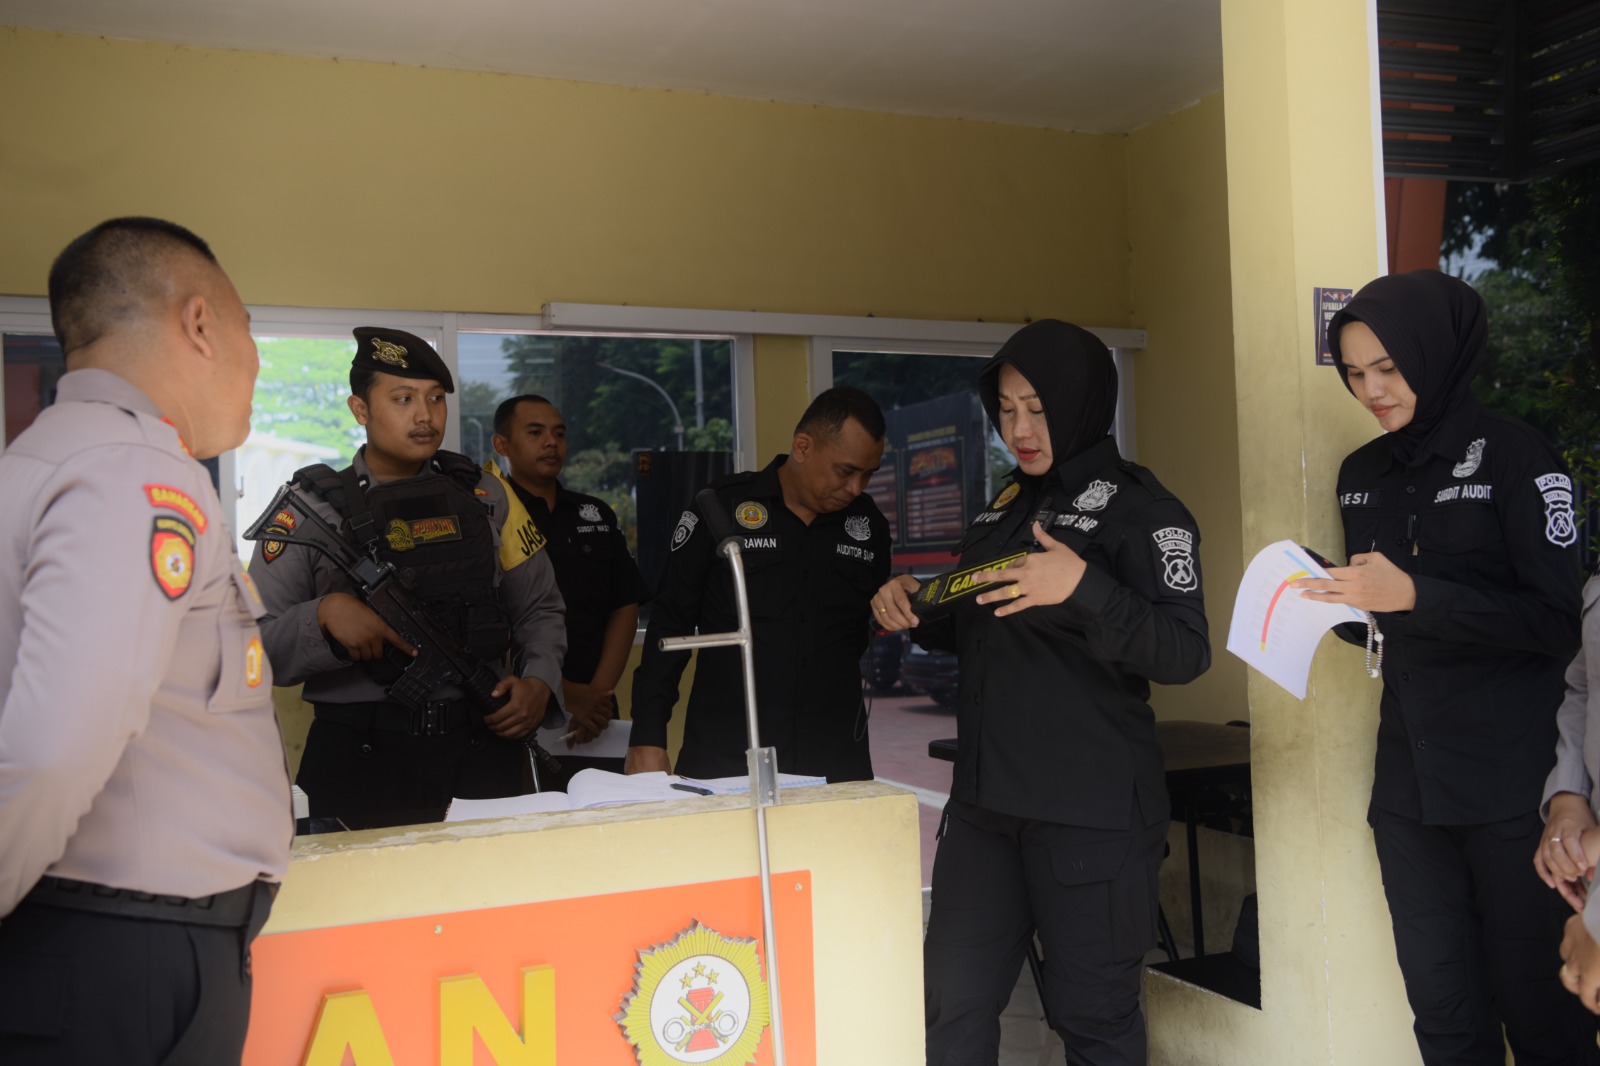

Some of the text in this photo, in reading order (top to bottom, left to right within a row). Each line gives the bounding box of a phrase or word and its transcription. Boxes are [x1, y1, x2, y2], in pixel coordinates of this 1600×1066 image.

[1538, 476, 1570, 489] POLDA
[1434, 484, 1492, 503] SUBDIT AUDIT
[1074, 515, 1099, 532] SMP
[516, 519, 545, 556] JAG
[1156, 529, 1192, 542] POLDA
[836, 543, 875, 563] AUDITOR SMP
